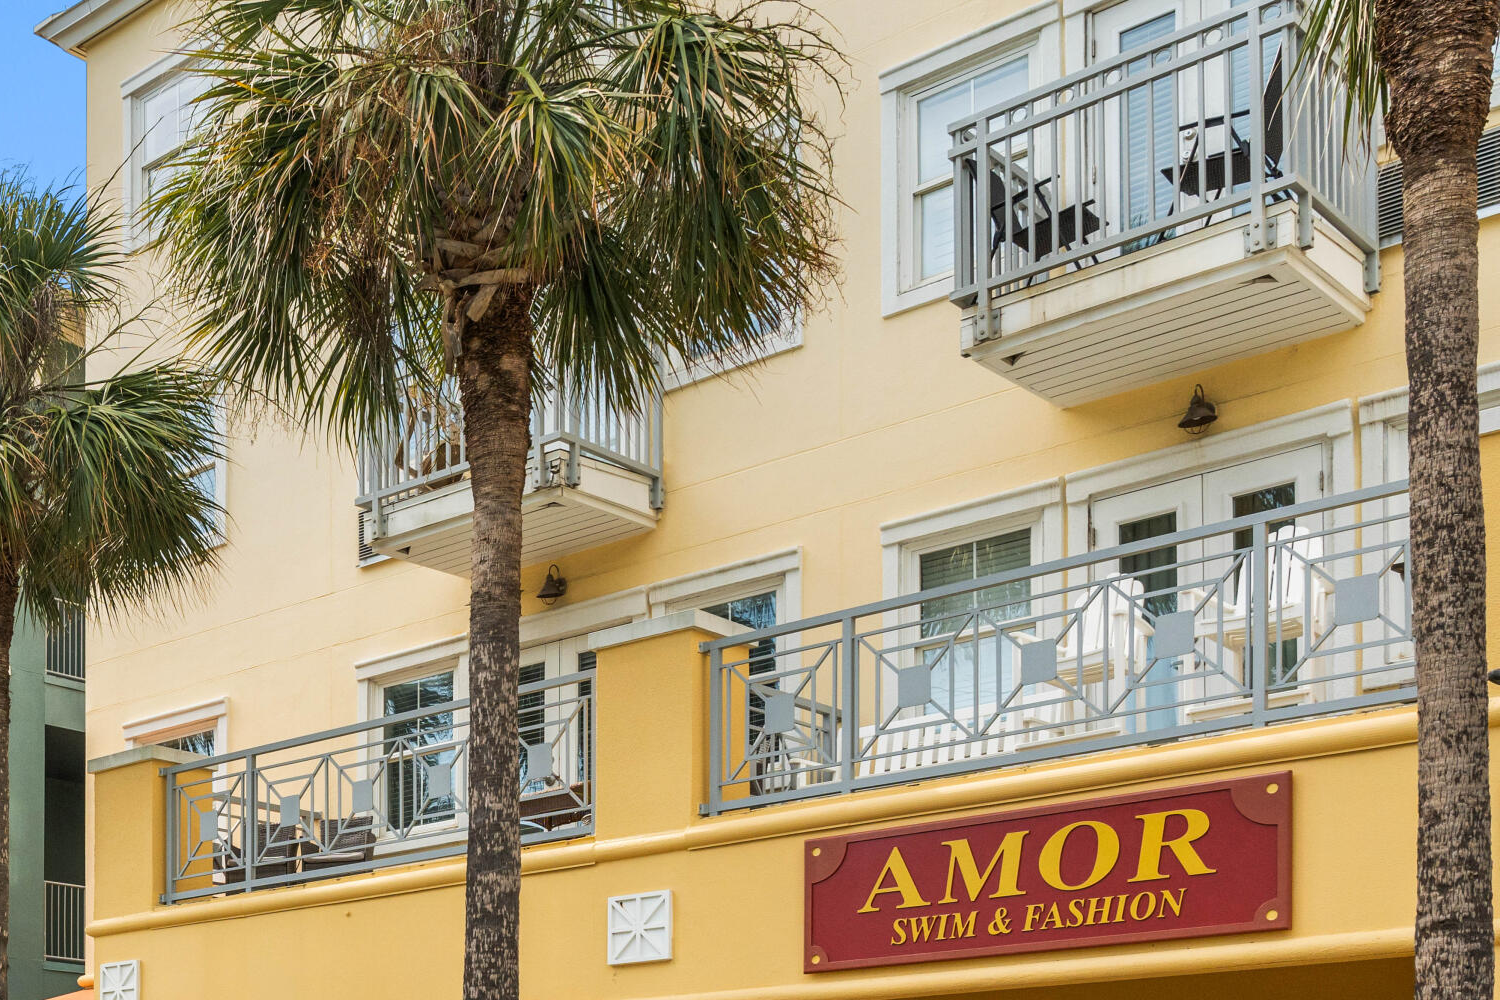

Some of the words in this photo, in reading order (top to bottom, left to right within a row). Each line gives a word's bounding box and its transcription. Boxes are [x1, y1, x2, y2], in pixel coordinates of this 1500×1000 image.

[857, 808, 1218, 914] AMOR
[891, 910, 980, 946] SWIM
[987, 907, 1013, 936] &
[1021, 887, 1188, 932] FASHION
